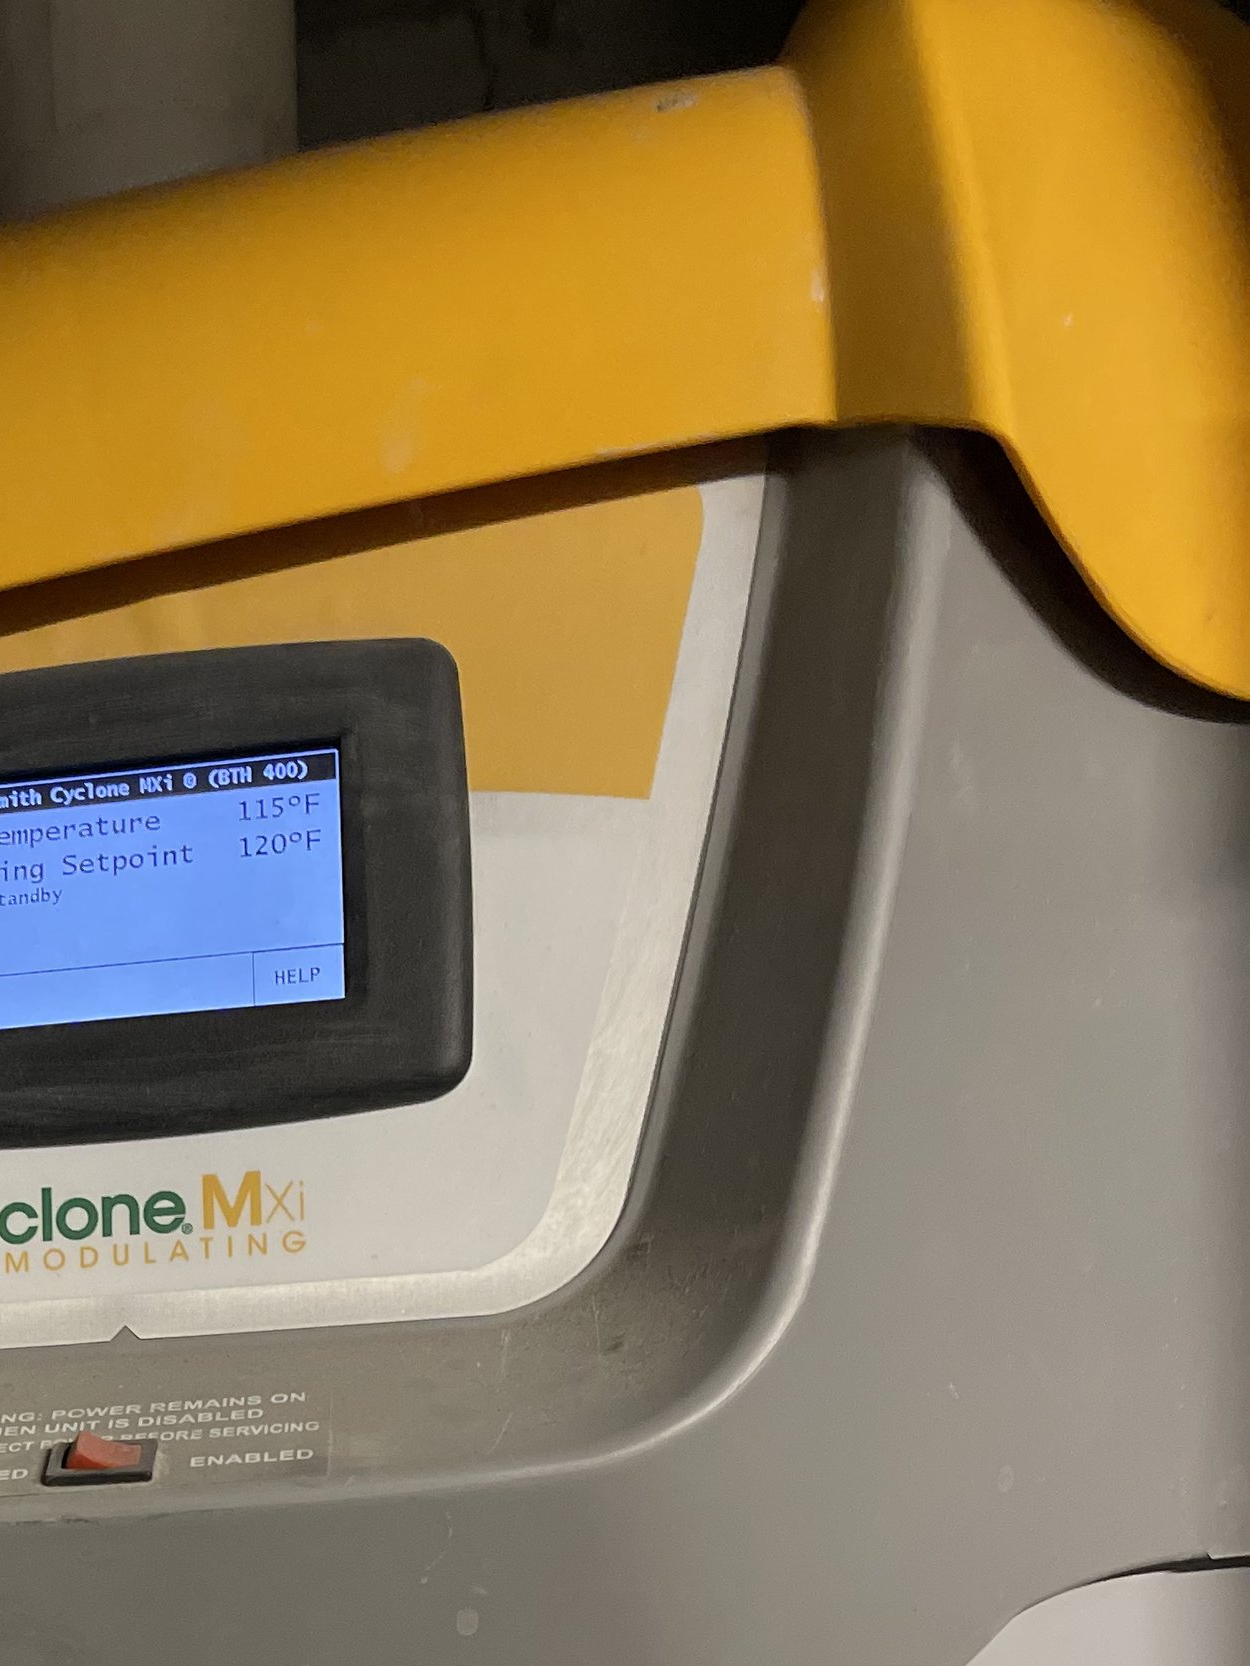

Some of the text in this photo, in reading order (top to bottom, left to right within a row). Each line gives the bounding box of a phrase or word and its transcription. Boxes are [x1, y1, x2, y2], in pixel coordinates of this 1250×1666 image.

[50, 780, 129, 804] Cyclone
[140, 775, 174, 794] MXi
[209, 767, 252, 789] (BTH
[263, 760, 308, 781] 400)
[239, 792, 320, 822] 115°F
[63, 843, 193, 875] Setpoint
[240, 830, 321, 858] 120°F
[275, 967, 320, 985] HELP
[5, 1230, 306, 1274] MODULATING
[52, 1404, 141, 1420] POWER
[150, 1395, 261, 1412] REMAINS
[271, 1392, 306, 1404] ON
[45, 1420, 99, 1434] UNIT
[108, 1417, 129, 1429] IS
[138, 1409, 263, 1427] DISABLED
[209, 1421, 320, 1438] SERVICING
[190, 1448, 314, 1467] ENABLED
